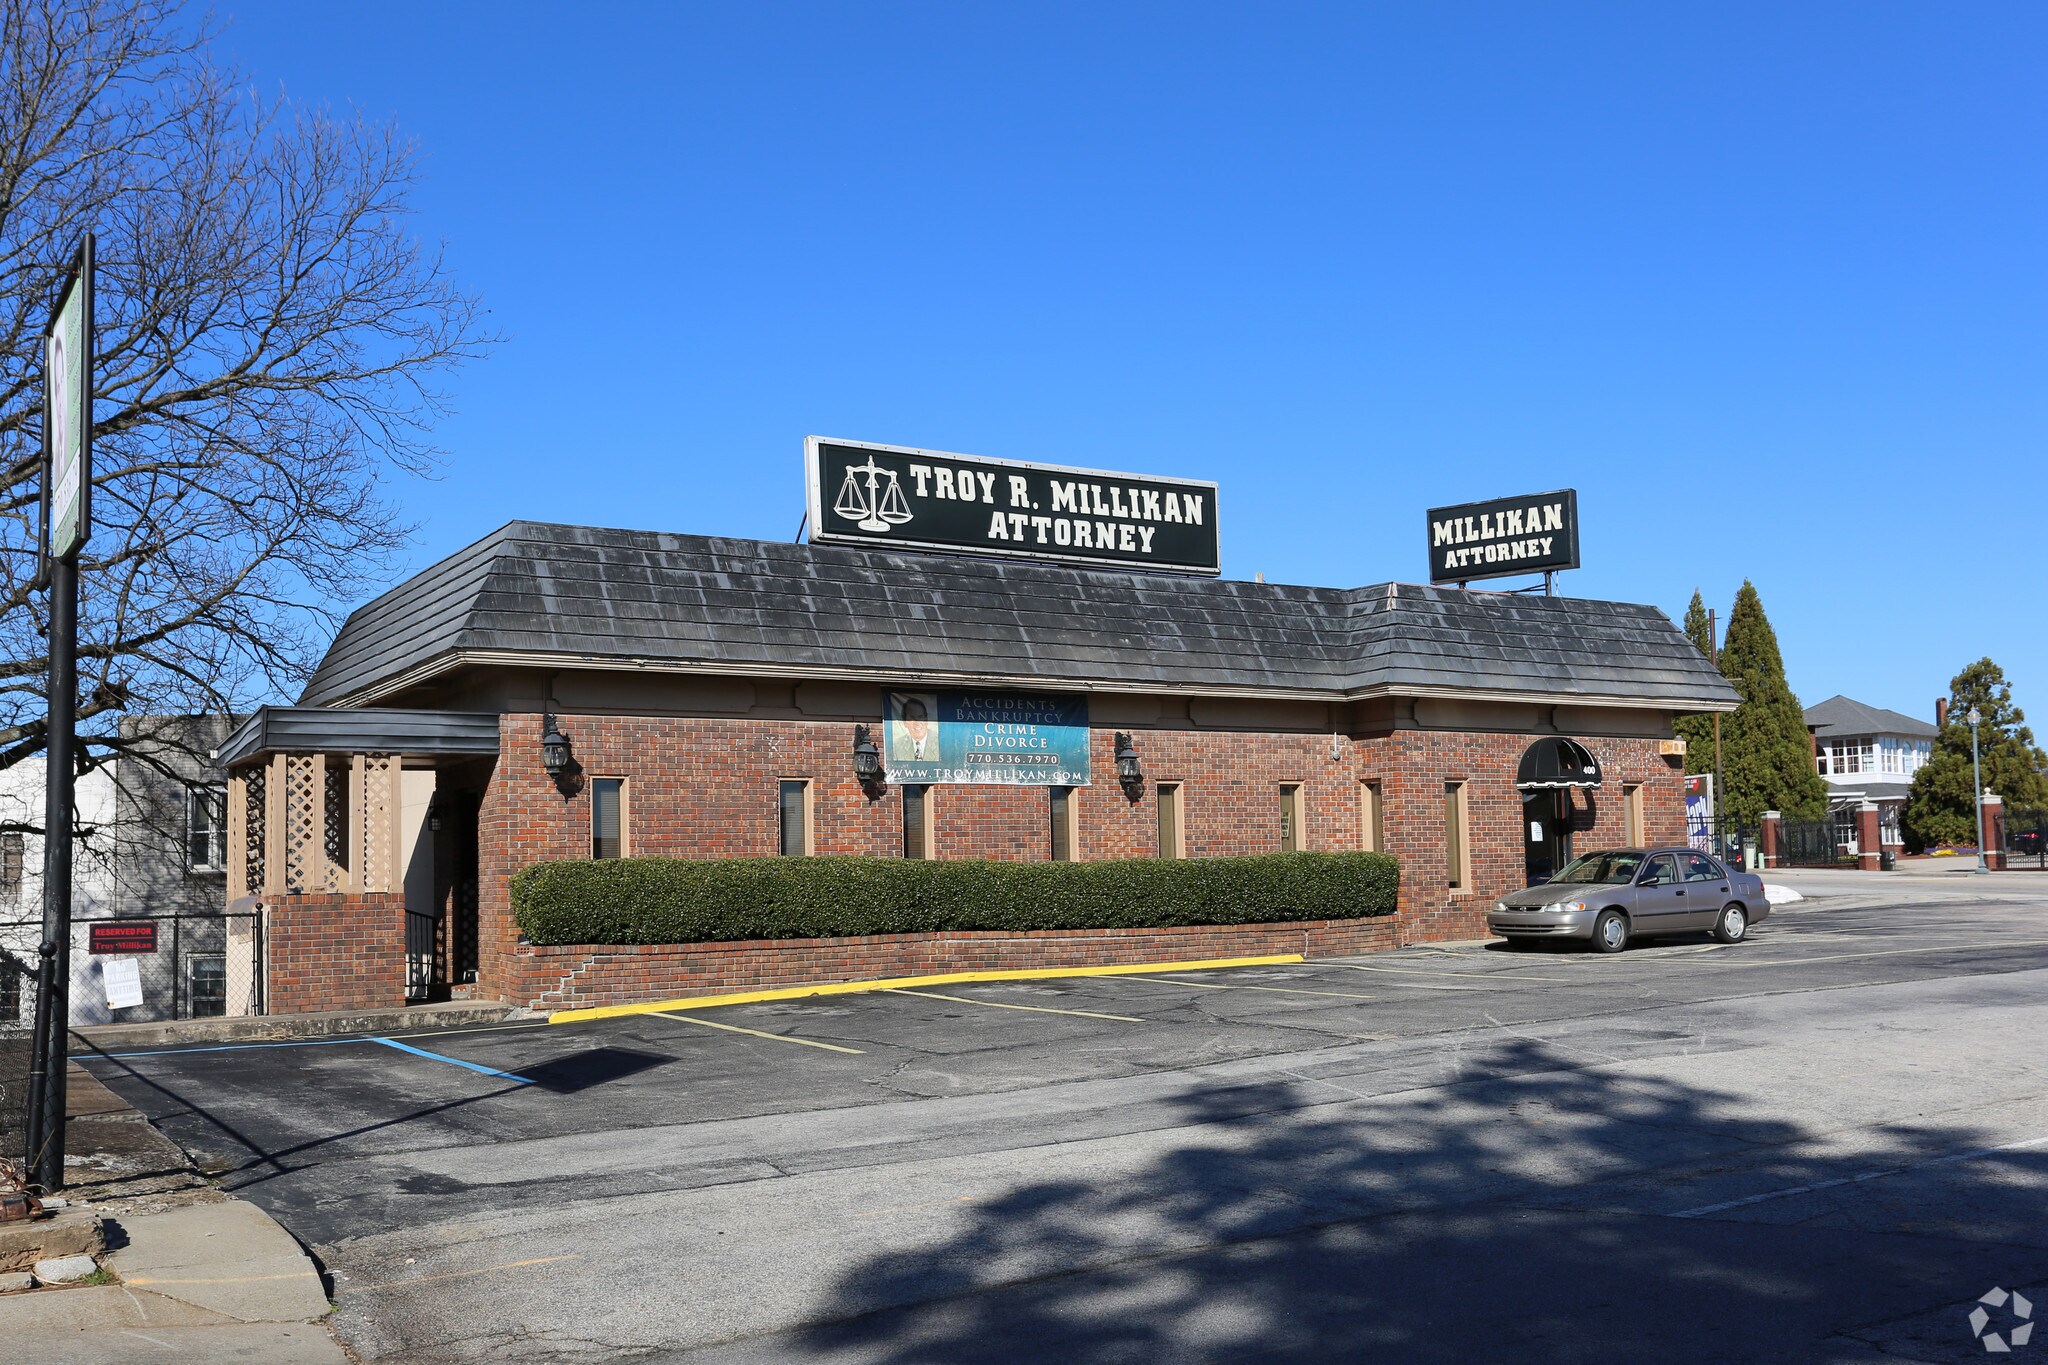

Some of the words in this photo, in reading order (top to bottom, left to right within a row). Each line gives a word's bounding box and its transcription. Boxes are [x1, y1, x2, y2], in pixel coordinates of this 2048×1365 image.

[909, 464, 995, 504] TROY
[1009, 475, 1038, 510] R.
[1050, 480, 1203, 526] MILLIKAN
[988, 511, 1156, 553] ATTORNEY
[1433, 504, 1563, 547] MILLIKAN
[1445, 537, 1553, 569] ATTORNEY
[961, 696, 1056, 711] ACCIDENTS
[956, 708, 1063, 724] BANKRUPTCY
[984, 722, 1037, 735] CRIME
[974, 735, 1048, 748] DIVORCE
[969, 754, 1058, 764] 770.536.7970
[1582, 765, 1596, 775] 400
[96, 928, 135, 936] RESERVED
